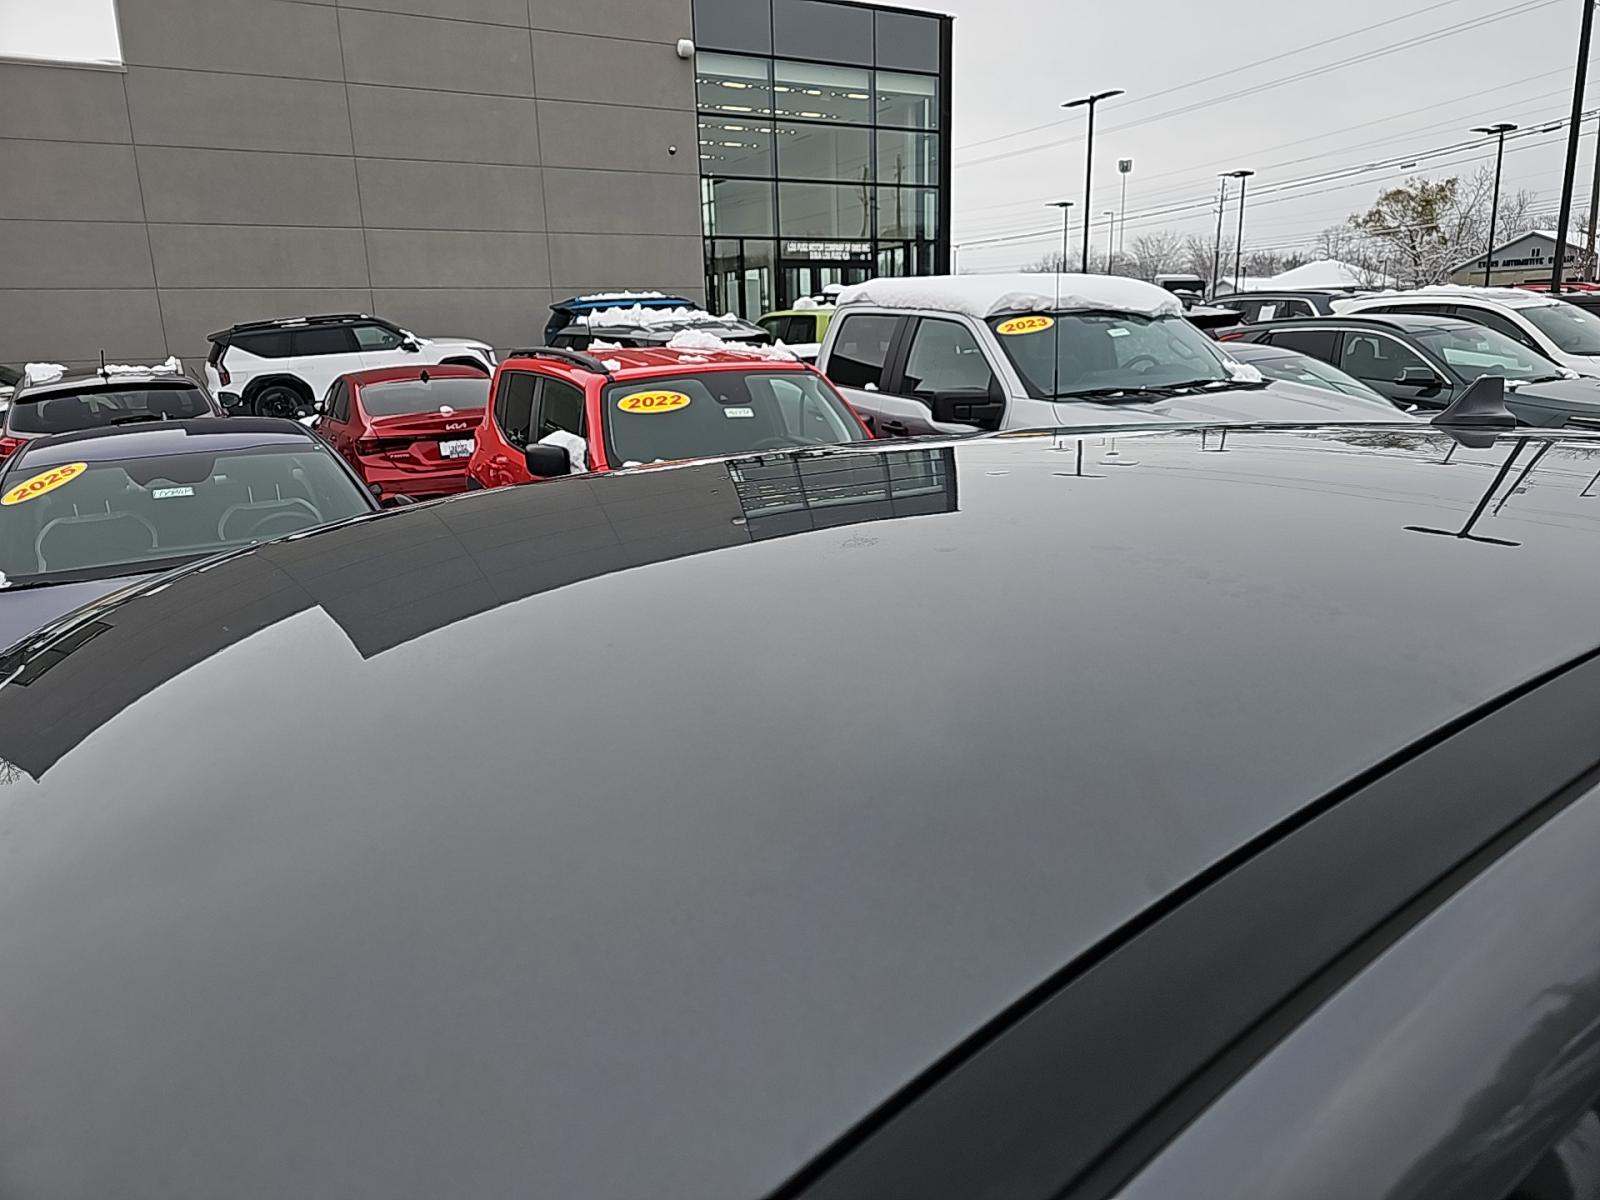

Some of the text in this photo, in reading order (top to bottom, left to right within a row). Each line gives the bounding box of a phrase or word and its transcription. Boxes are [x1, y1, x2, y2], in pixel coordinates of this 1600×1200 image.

[1004, 318, 1049, 332] 2023
[628, 394, 683, 409] 2022
[445, 422, 468, 431] KIA
[13, 466, 77, 501] 2025
